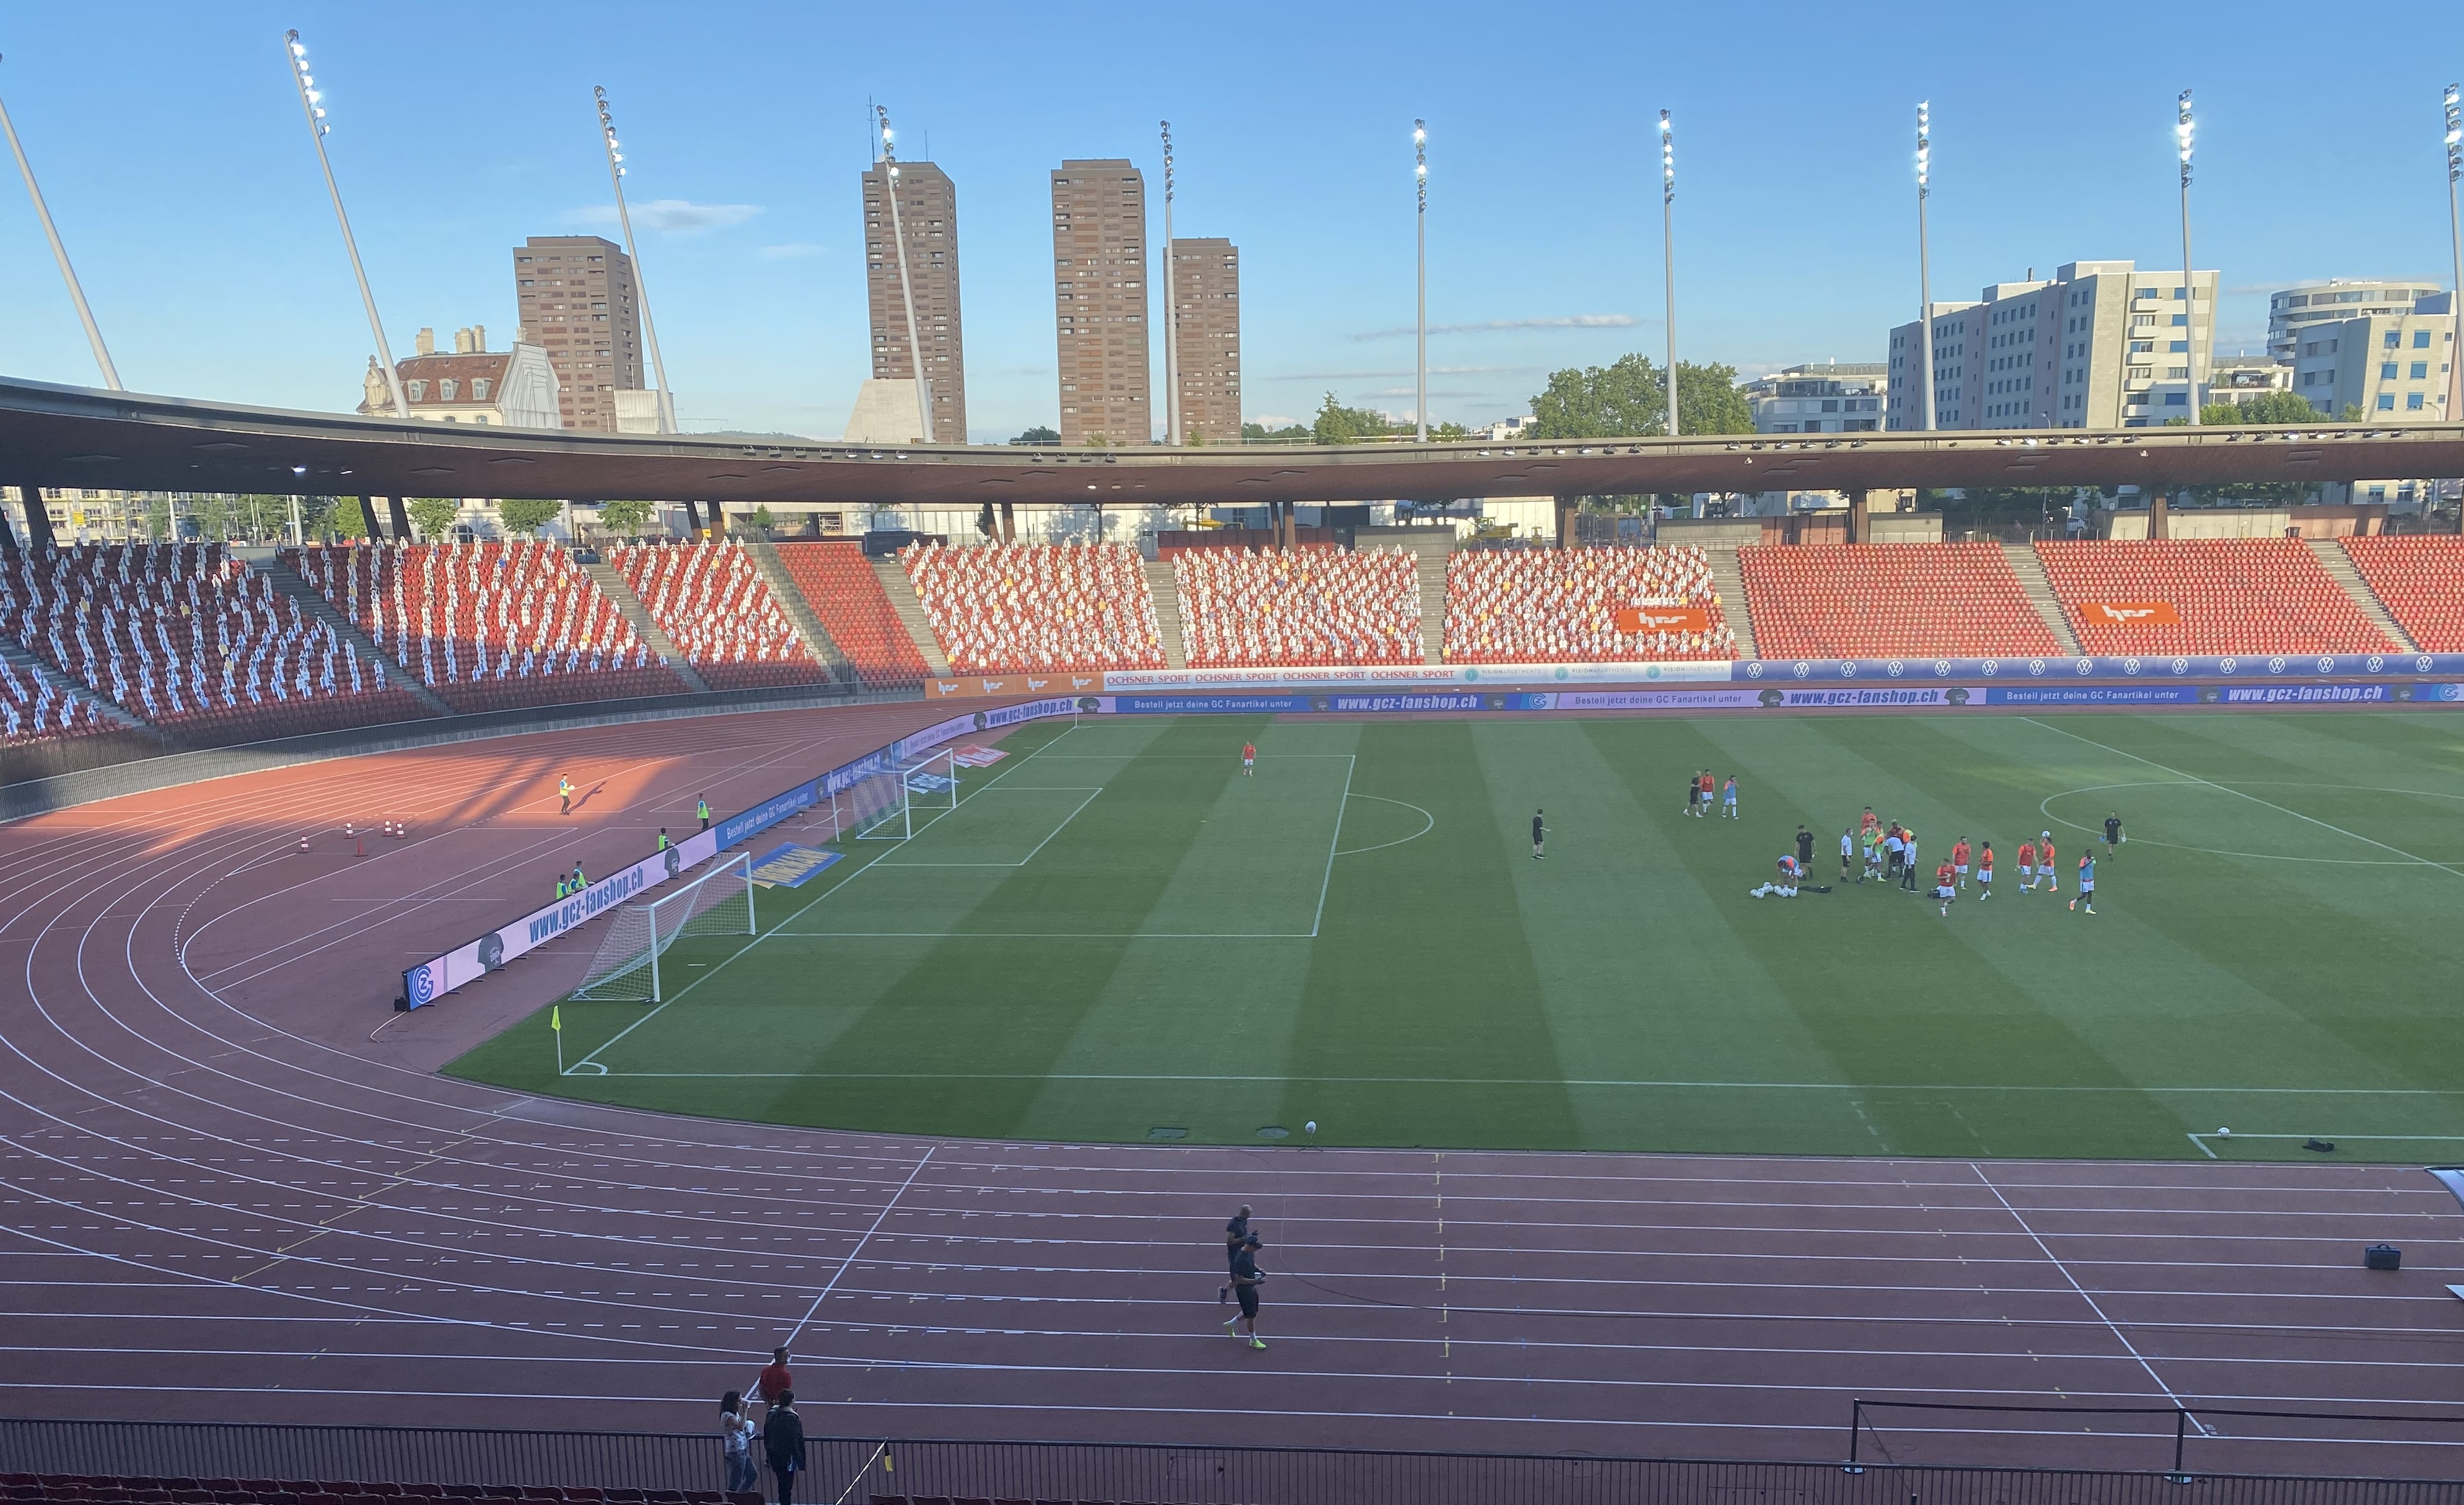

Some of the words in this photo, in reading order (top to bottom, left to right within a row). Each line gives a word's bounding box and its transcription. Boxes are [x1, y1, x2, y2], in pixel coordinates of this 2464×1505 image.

[1638, 612, 1687, 628] hrs
[2102, 605, 2155, 621] hrs
[1107, 675, 1154, 684] OCHSNER
[1158, 674, 1190, 683] SPORT
[1195, 674, 1242, 682] OCHSNER
[1246, 672, 1278, 681] SPORT
[1283, 672, 1330, 680] OCHSNER
[1334, 671, 1366, 679] SPORT
[1371, 670, 1418, 679] OCHSNER
[1423, 670, 1455, 678] SPORT
[1790, 690, 1939, 704] www.gcz-fanshop.ch
[2007, 691, 2038, 700] Bestell
[2040, 691, 2060, 702] jetzt
[2063, 691, 2087, 700] deine
[2090, 691, 2103, 700] GC
[2107, 691, 2151, 699] Fanartikel
[2228, 685, 2383, 701] www.gcz-fanshop.ch
[1134, 700, 1163, 708] Bestell
[1165, 700, 1183, 710] jetzt
[1186, 700, 1208, 708] deine
[1226, 700, 1268, 708] Fanartikel
[1337, 695, 1477, 710] www.gcz-fanshop.ch
[1575, 696, 1605, 704] Bestell
[1607, 696, 1626, 706] jetzt
[989, 698, 1072, 725] www.gcz-fanshop.ch
[727, 820, 743, 840] Bestell
[744, 817, 755, 834] jetzt
[756, 812, 768, 825] deine
[768, 805, 776, 818] GC
[776, 796, 797, 814] Fanartikel
[797, 792, 809, 805] unter
[529, 865, 644, 944] www.gcz-fanshop.ch
